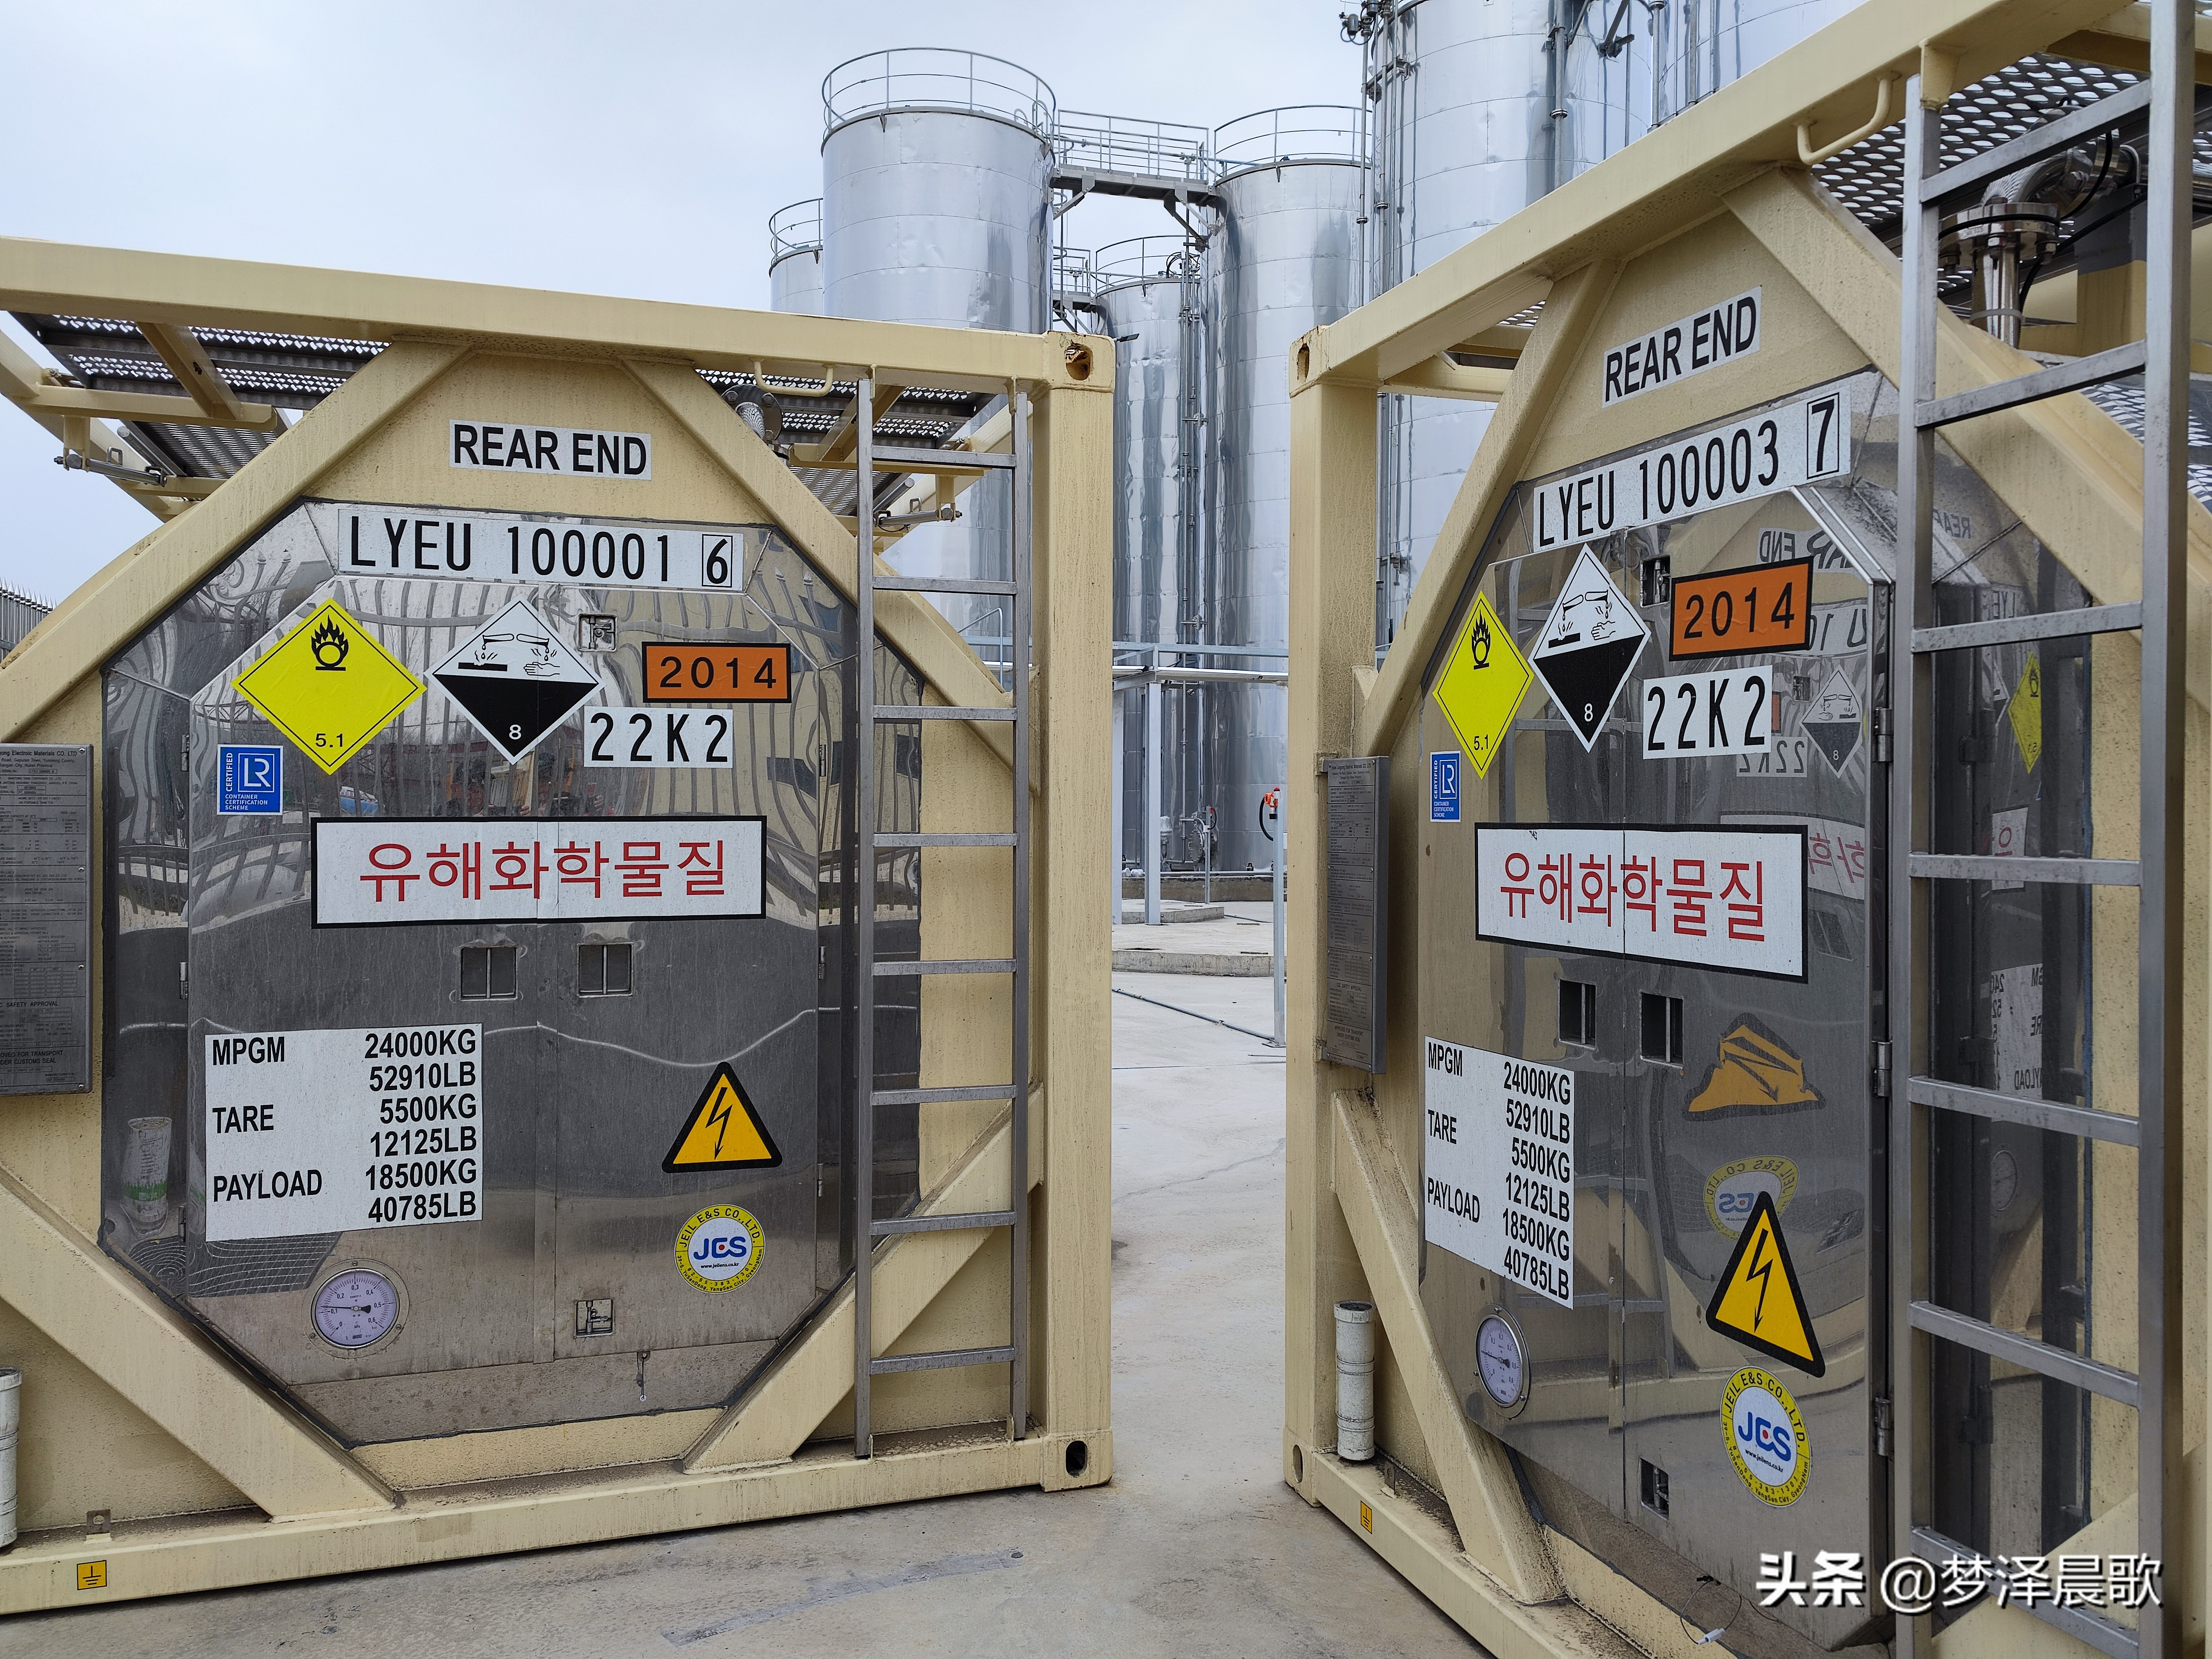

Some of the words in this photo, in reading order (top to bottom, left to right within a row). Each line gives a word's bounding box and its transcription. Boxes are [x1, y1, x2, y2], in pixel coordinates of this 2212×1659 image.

[1606, 328, 1681, 402] REAR
[1692, 297, 1756, 370] END
[454, 424, 560, 470] REAR
[573, 433, 646, 475] END
[1540, 471, 1614, 547] LYEU
[1640, 420, 1778, 520] 100003
[1810, 399, 1834, 472] 7
[352, 516, 471, 571] LYEU
[508, 527, 667, 581] 100001
[706, 538, 728, 584] 6
[1684, 582, 1794, 639] 2014
[660, 656, 776, 688] 2014
[509, 725, 521, 739] 8
[1585, 703, 1593, 721] 8
[1648, 676, 1765, 750] 22K2
[316, 734, 342, 747] 5.1
[591, 713, 727, 762] 22K2
[1474, 735, 1488, 750] 5.1
[244, 758, 271, 787] LR
[1442, 764, 1455, 793] LR
[360, 841, 724, 902] 유해화학물질
[1501, 853, 1764, 942] 유해화학물질
[213, 1037, 284, 1065] MPGM
[365, 1029, 475, 1058] 24000KG
[370, 1062, 475, 1091] 52910LB
[1429, 1042, 1462, 1077] MPGM
[1504, 1062, 1570, 1105] 24000KG
[213, 1105, 274, 1133] TARE
[380, 1093, 476, 1124] 5500KG
[1506, 1098, 1570, 1144] 52910LB
[371, 1126, 476, 1157] 12125LB
[1428, 1109, 1456, 1144] TARE
[1512, 1137, 1570, 1183] 5500KG
[214, 1170, 322, 1202] PAYLOAD
[366, 1158, 476, 1190] 18500KG
[1506, 1172, 1569, 1222] 12125LB
[368, 1191, 476, 1223] 40785LB
[679, 1225, 697, 1248] JEIL
[696, 1208, 720, 1223] E&S
[1428, 1177, 1480, 1223] PAYLOAD
[1503, 1208, 1569, 1261] 18500KG
[746, 1249, 762, 1278] GyeongNam
[1504, 1246, 1569, 1300] 40785LB
[1724, 1382, 1741, 1413] JEIL
[1740, 1372, 1763, 1387] E&S
[1745, 1448, 1784, 1473] www.jeilens.co.kr
